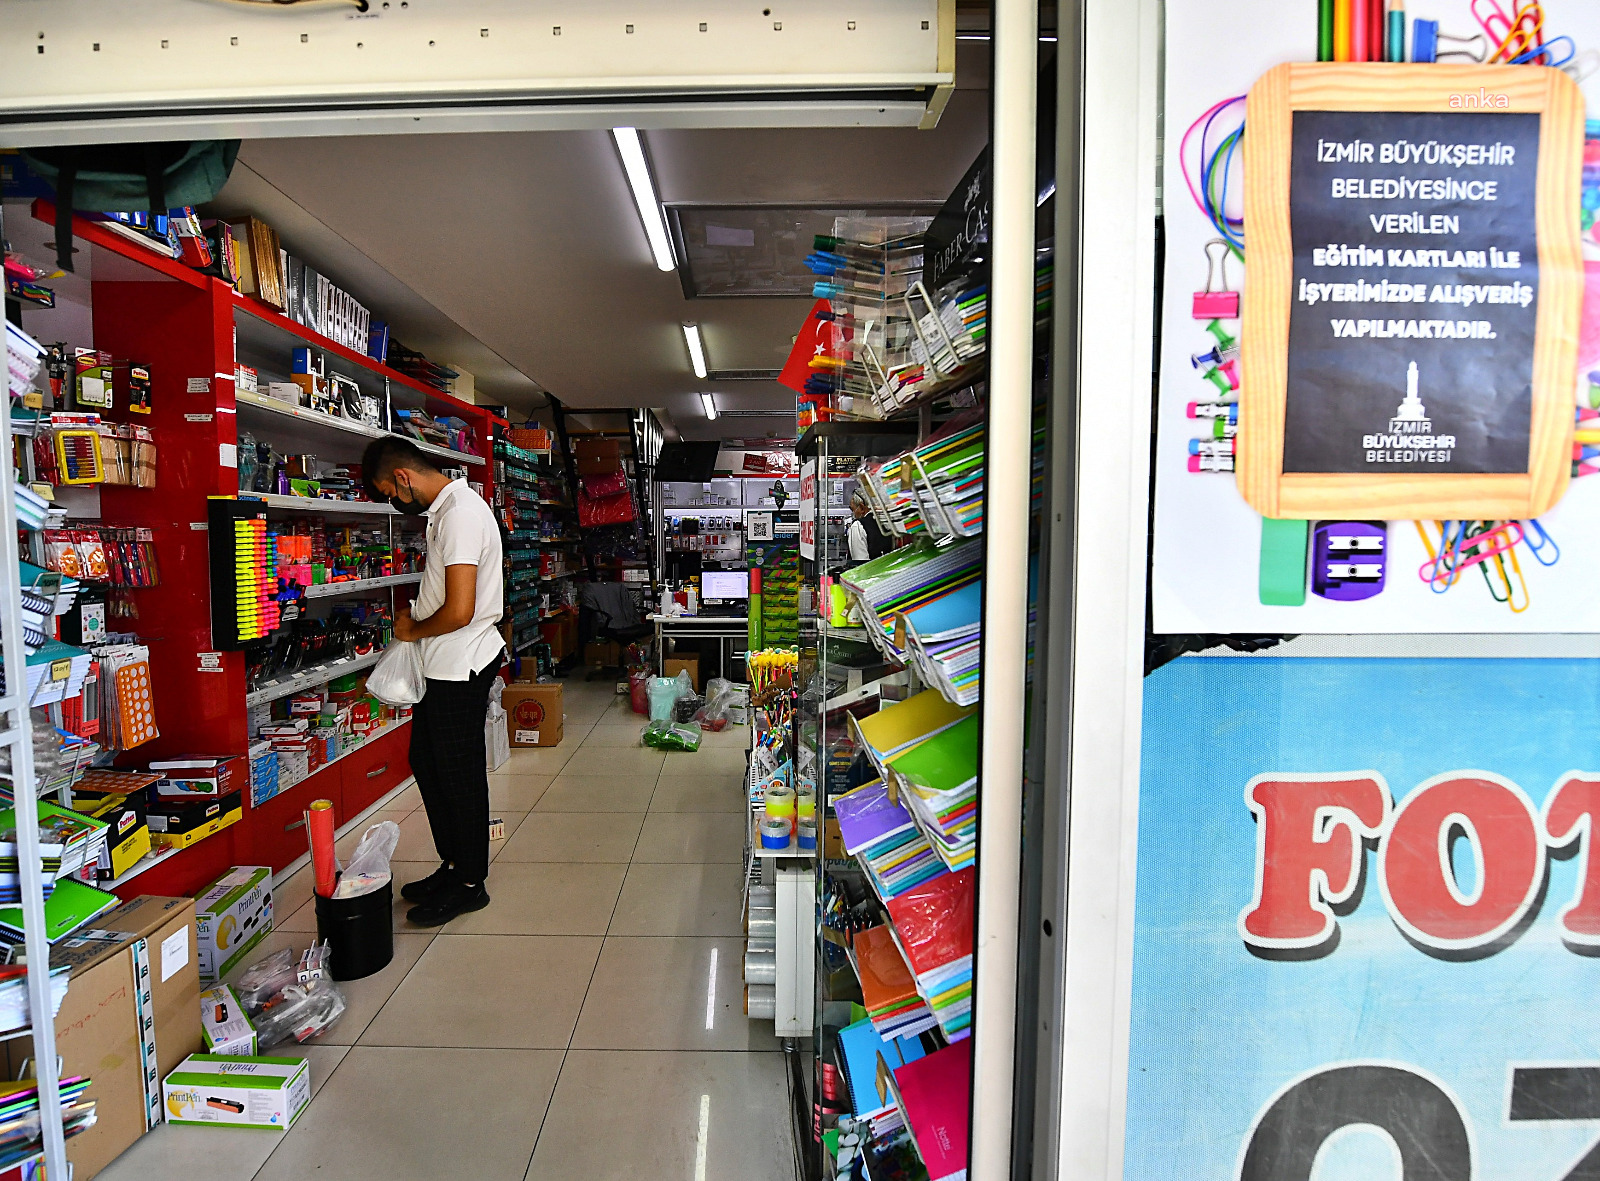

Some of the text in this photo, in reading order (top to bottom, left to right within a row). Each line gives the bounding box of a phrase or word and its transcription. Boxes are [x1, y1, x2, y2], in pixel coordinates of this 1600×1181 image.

[1317, 139, 1515, 167] İZMİR BÜYÜKŞEHİR
[1331, 177, 1498, 201] BELEDİYESİNCE
[1370, 211, 1459, 234] VERİLEN
[1313, 244, 1521, 269] EĞİTİM KARTLARI İLE
[1299, 278, 1534, 308] İŞYERİMİZDE ALIŞVERİŞ
[1330, 319, 1497, 339] YAPILMAKTADIR.
[167, 1091, 200, 1103] PrintPen
